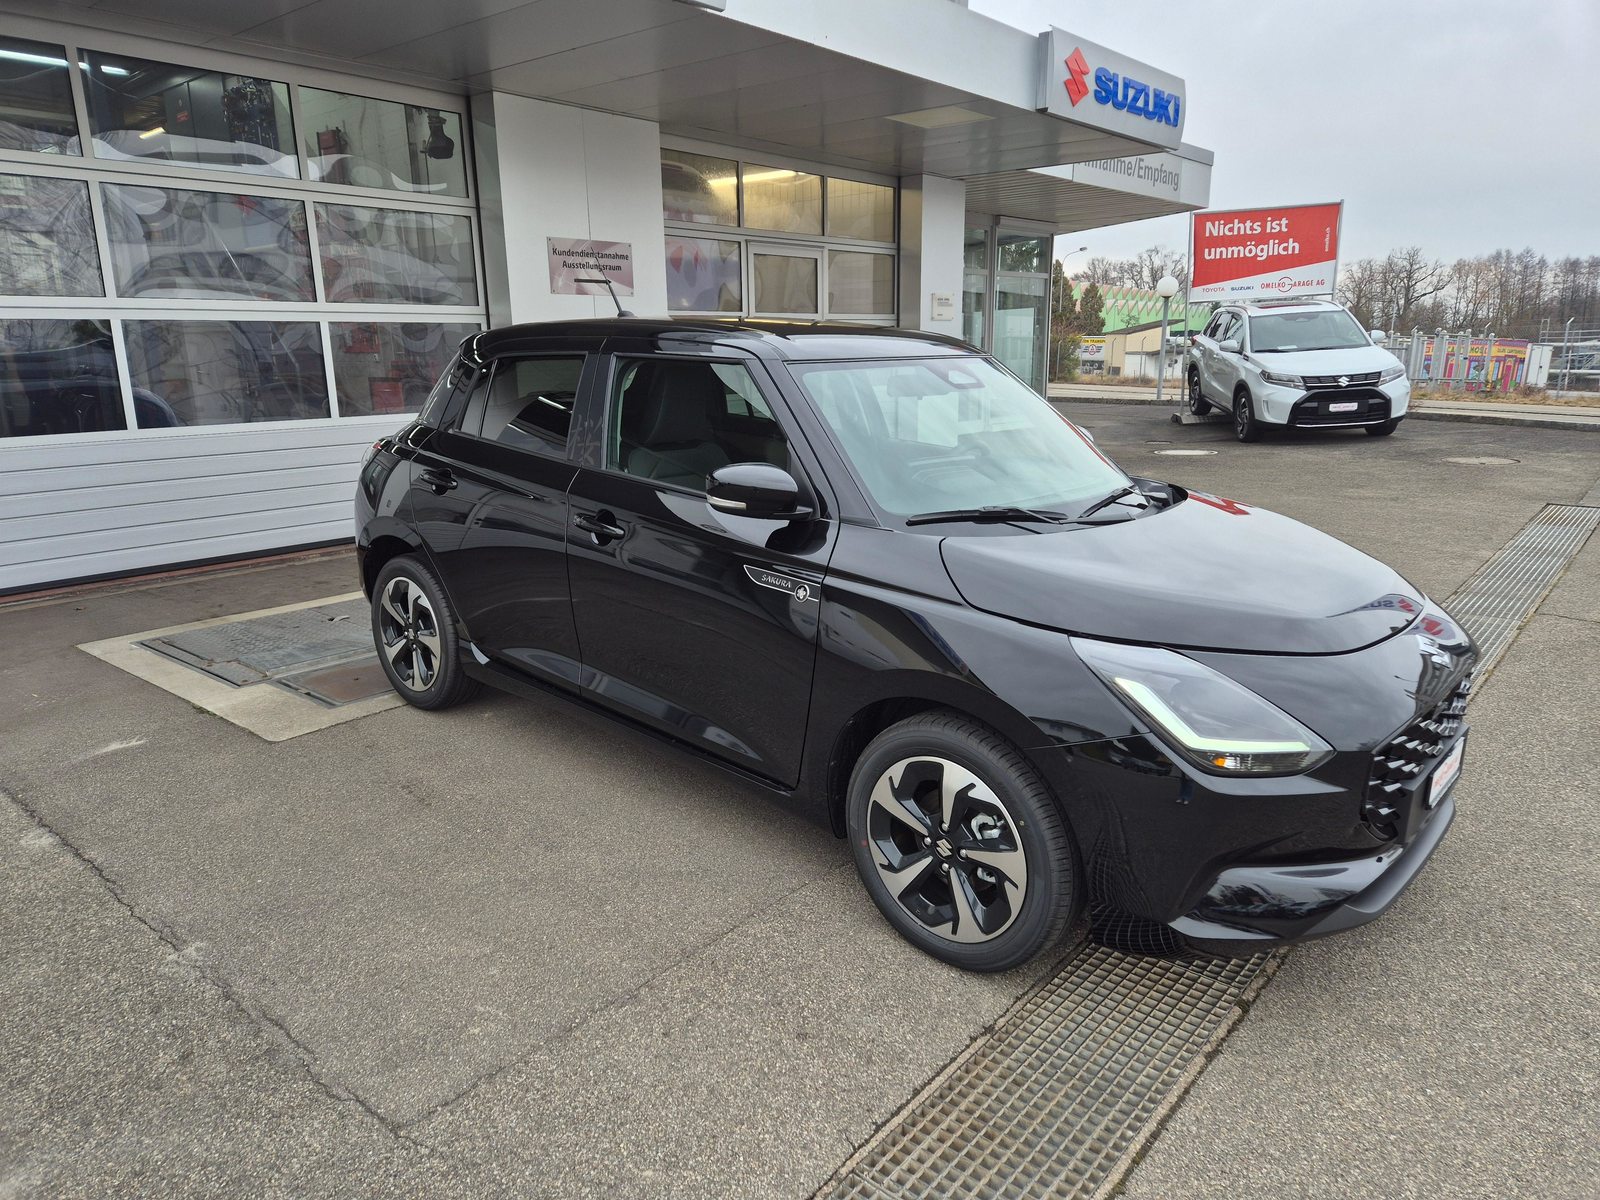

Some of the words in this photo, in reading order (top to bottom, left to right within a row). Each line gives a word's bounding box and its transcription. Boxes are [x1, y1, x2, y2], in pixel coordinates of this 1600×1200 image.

[1094, 67, 1180, 127] SUZUKI
[1205, 219, 1261, 237] Nichts
[1266, 217, 1288, 233] ist
[552, 248, 629, 261] Kundendienstannahme
[1204, 238, 1299, 260] unmöglich
[562, 260, 622, 272] Ausstellungsraum
[1260, 281, 1286, 289] OMELKO
[761, 574, 791, 588] SAKURA
